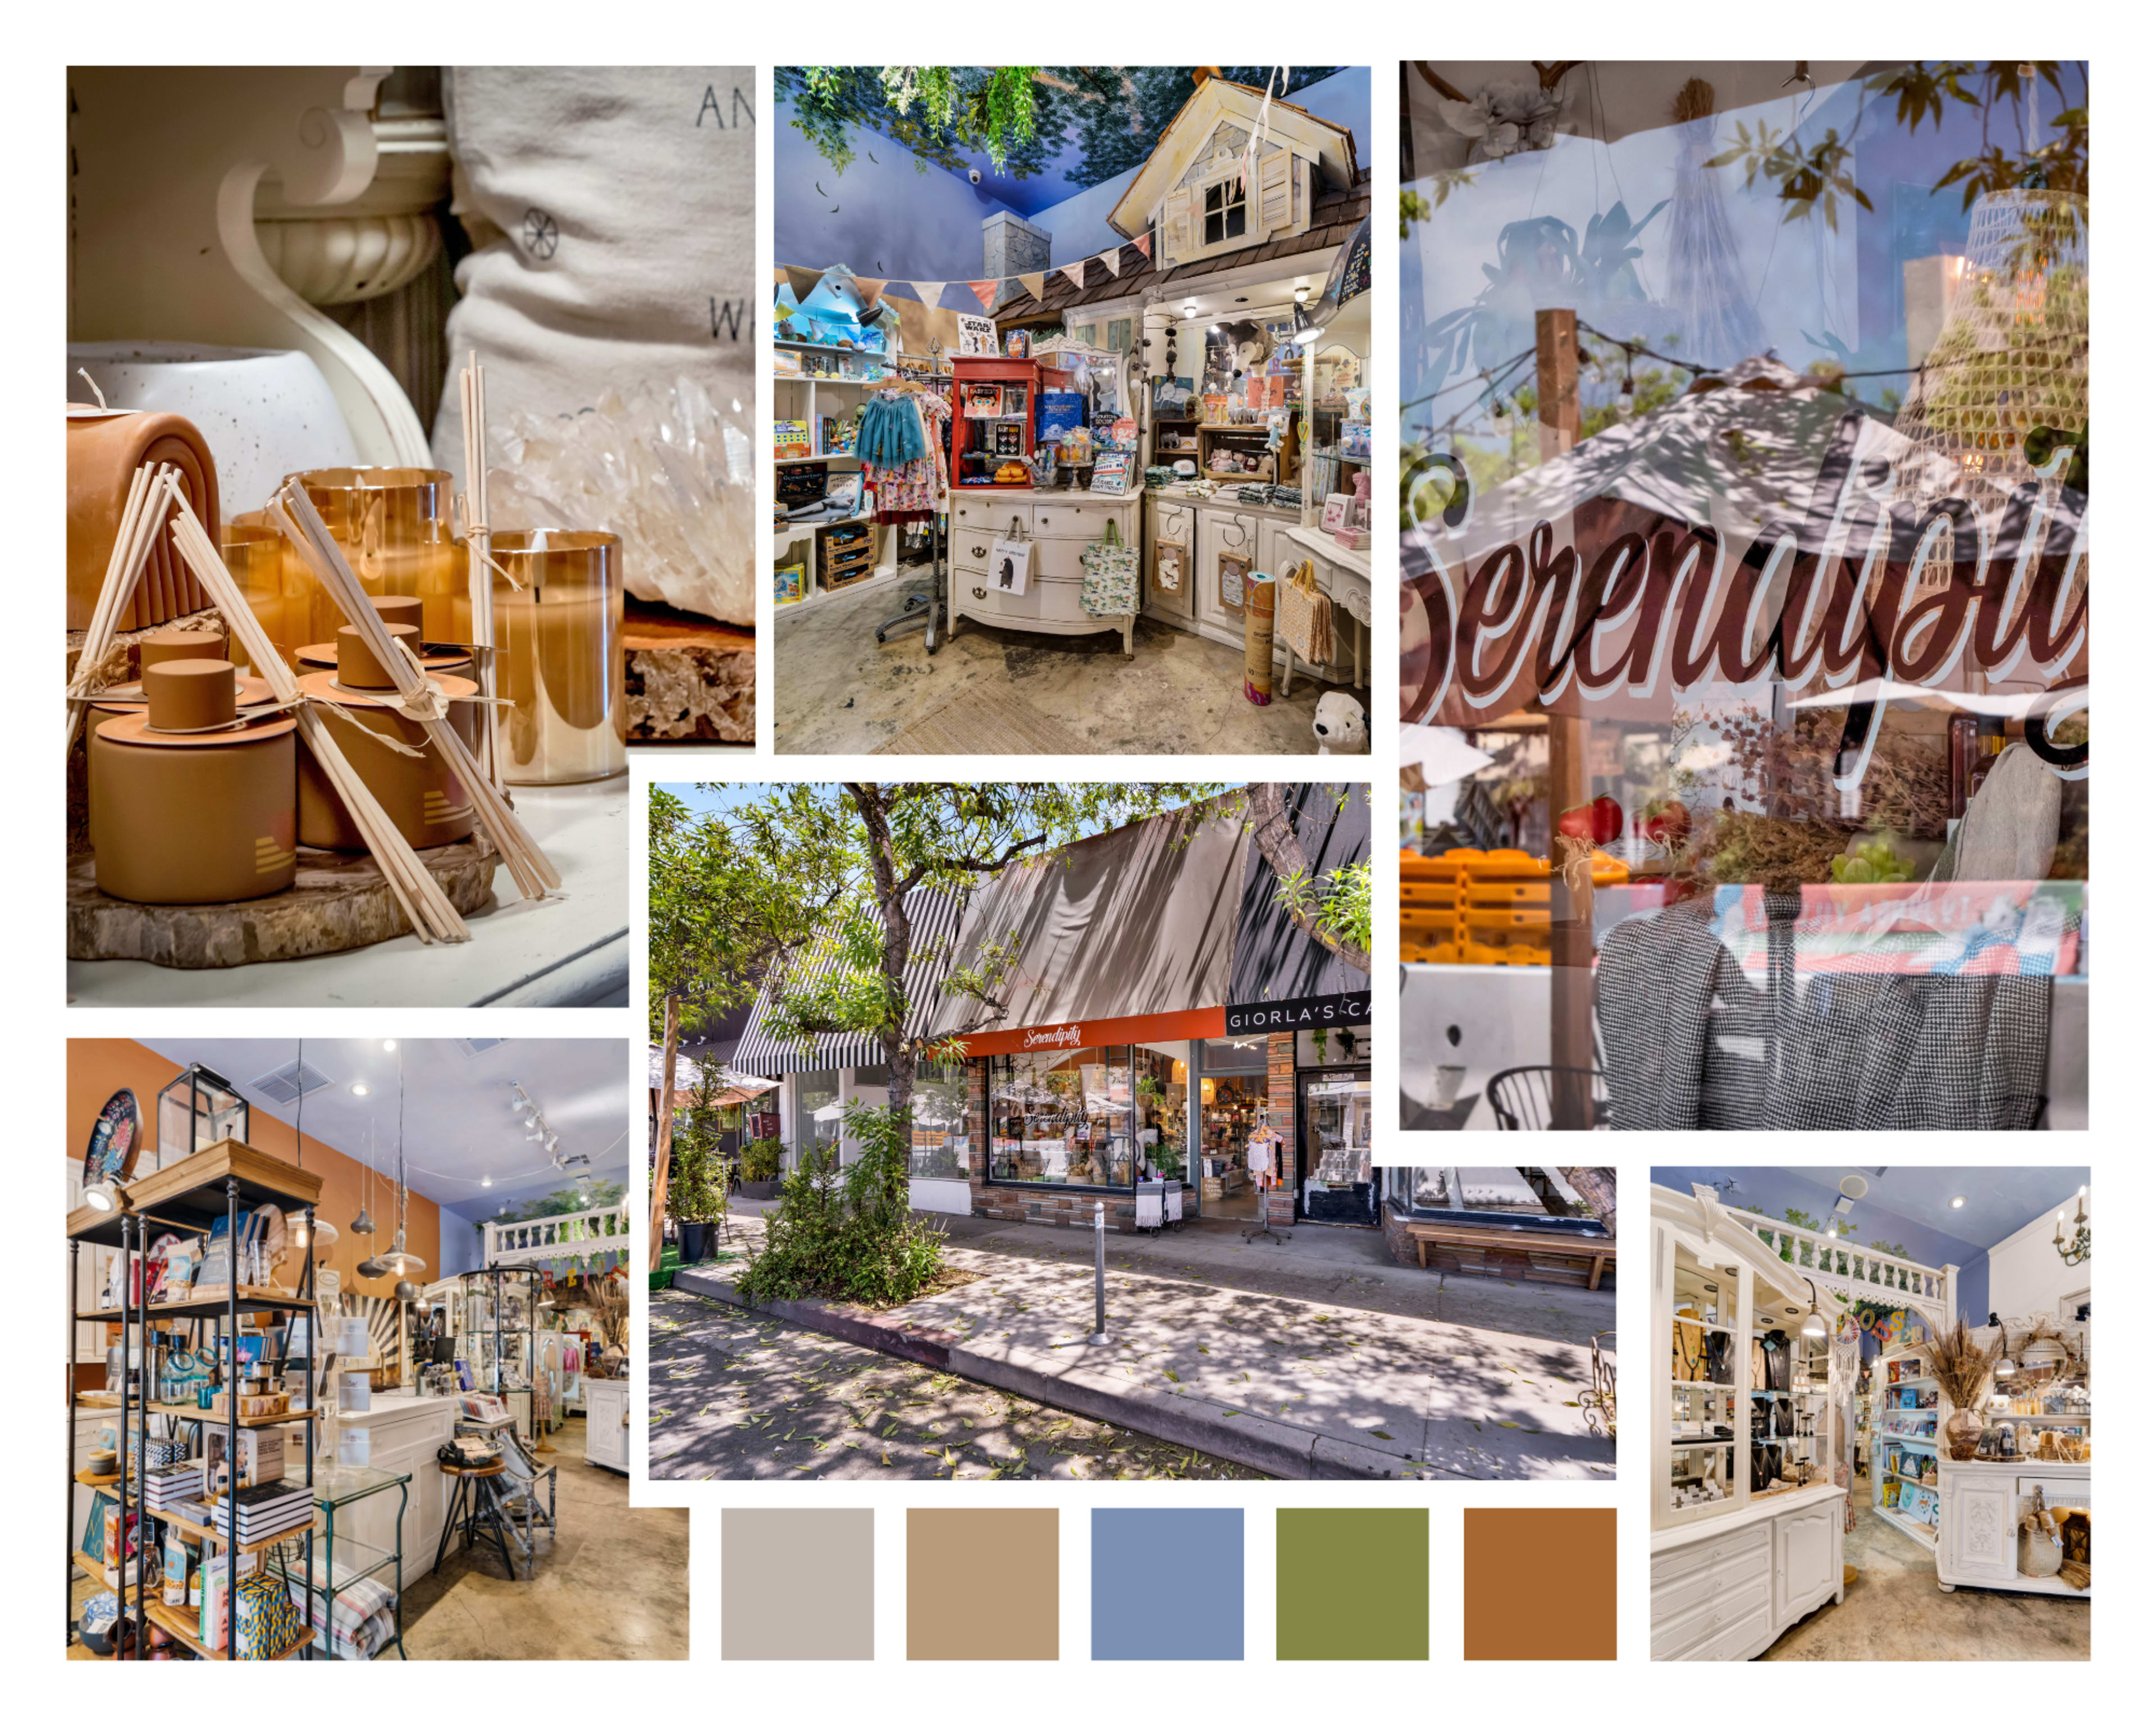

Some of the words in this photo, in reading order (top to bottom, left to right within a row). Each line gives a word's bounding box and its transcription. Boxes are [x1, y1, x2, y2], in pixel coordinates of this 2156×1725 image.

[1230, 1005, 1334, 1027] GIORLA'S
[1024, 1025, 1081, 1048] Serendipity
[1023, 1105, 1089, 1131] Serendipity
